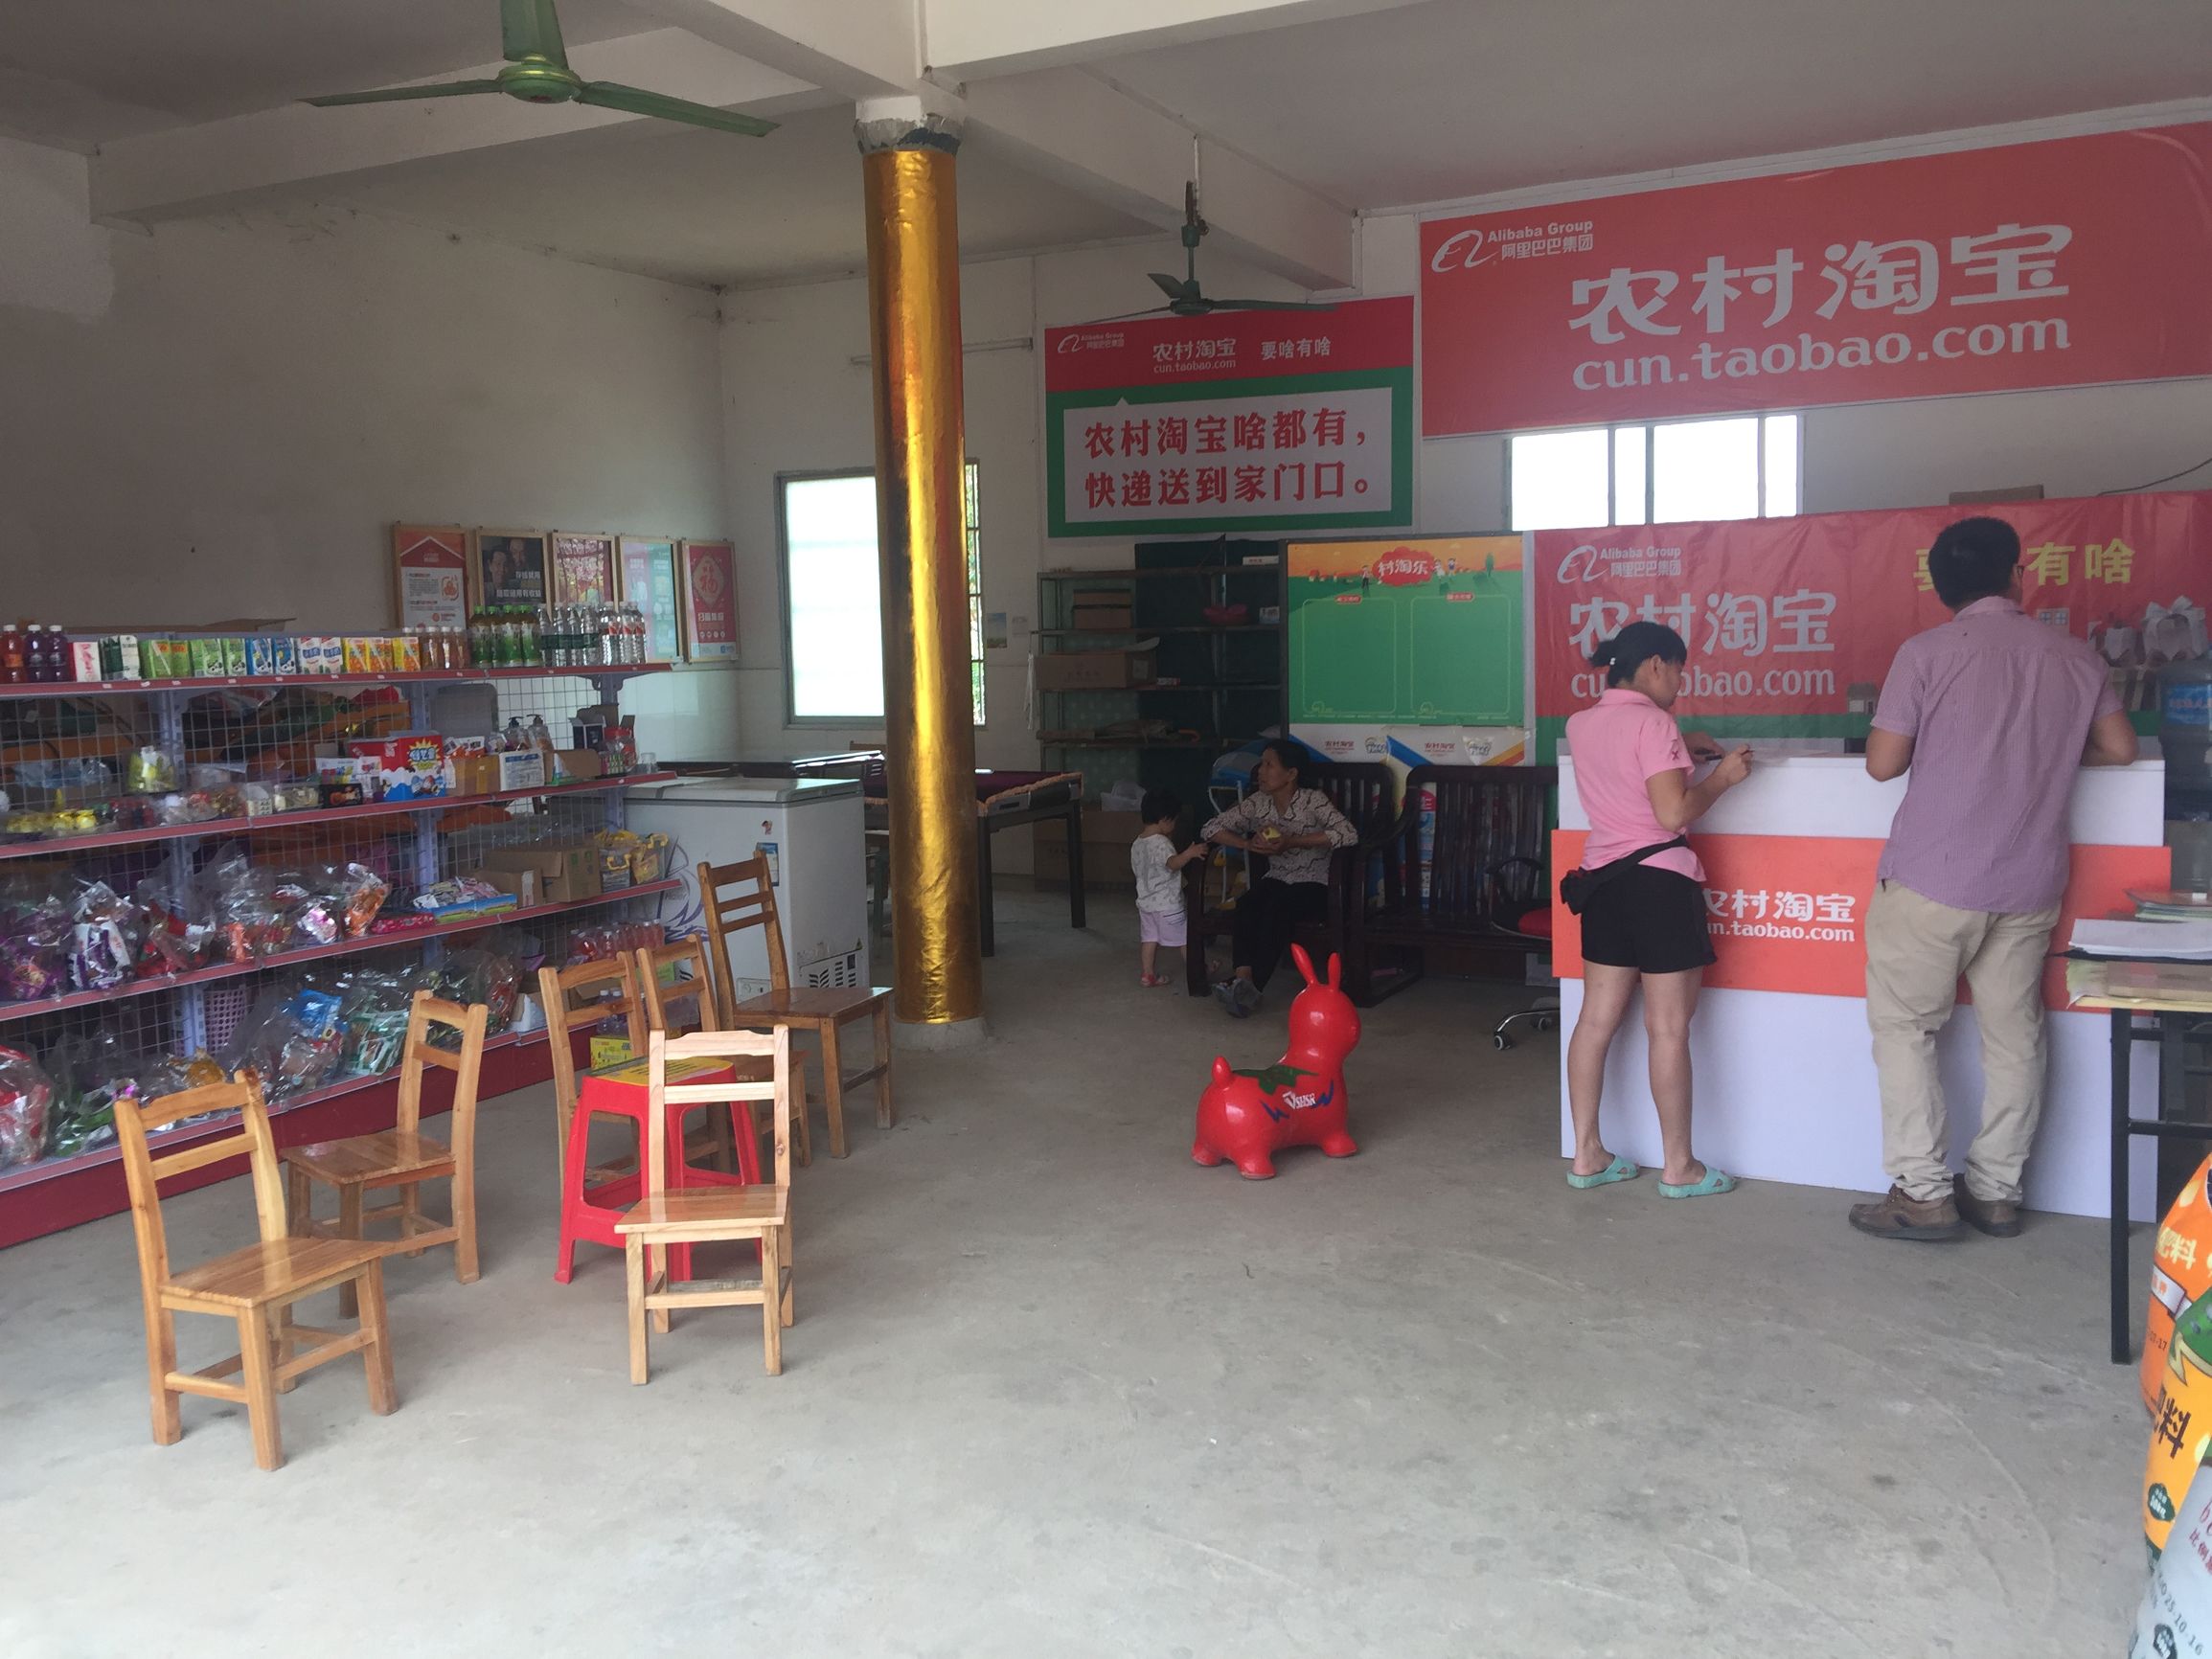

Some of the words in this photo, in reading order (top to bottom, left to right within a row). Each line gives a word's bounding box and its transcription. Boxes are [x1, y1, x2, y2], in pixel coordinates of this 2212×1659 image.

[1488, 226, 1542, 242] Alibaba
[1548, 221, 1593, 235] Group
[1502, 235, 1593, 261] 阿里巴巴集团
[1569, 222, 2073, 345] 农村淘宝
[1152, 338, 1236, 361] 农村淘宝
[1261, 336, 1332, 360] 要啥有啥
[1572, 314, 2071, 391] cun.taobao.com
[1153, 358, 1236, 374] cun.taobao.com
[1084, 461, 1368, 509] 快递送到家门口。
[1600, 548, 1642, 559] Alibaba
[1646, 546, 1681, 559] Group
[1610, 559, 1681, 578] 阿里巴巴集团
